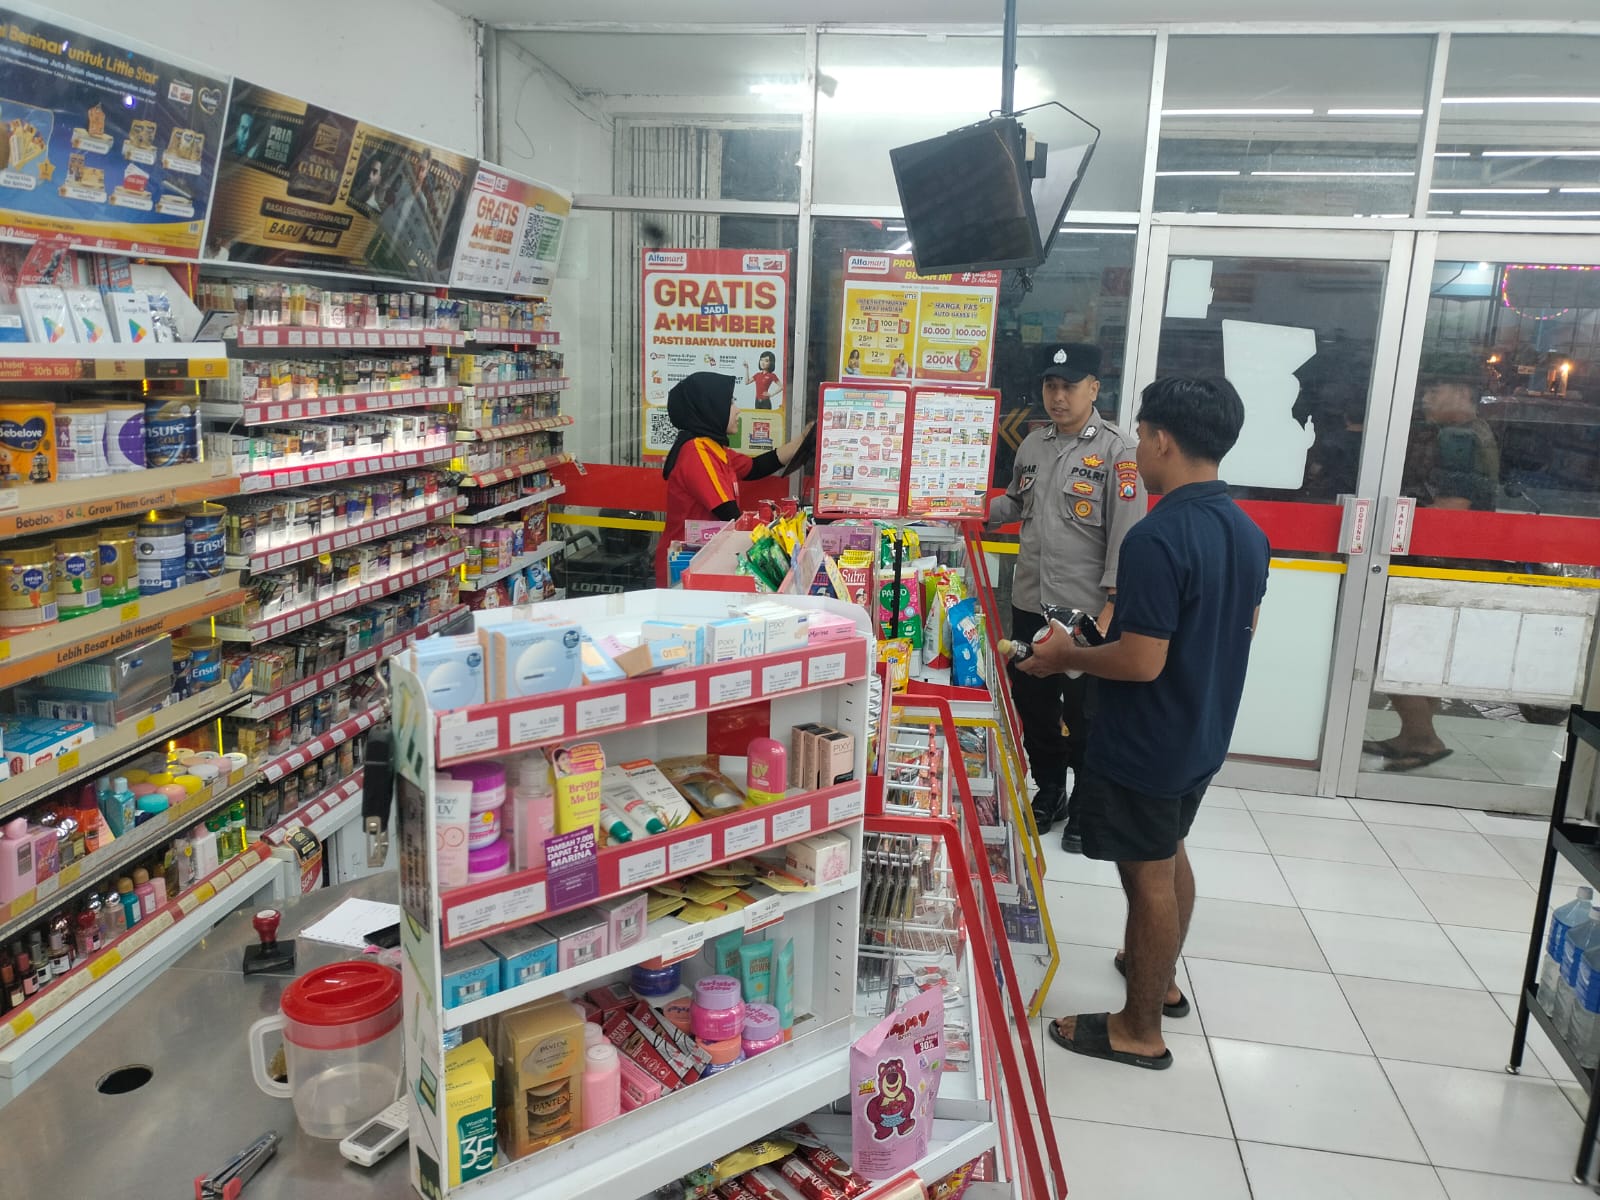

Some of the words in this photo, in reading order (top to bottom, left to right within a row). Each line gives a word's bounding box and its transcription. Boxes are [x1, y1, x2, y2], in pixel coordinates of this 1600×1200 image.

[68, 46, 104, 69] untuk
[106, 57, 135, 78] Little
[135, 66, 159, 85] Star
[268, 125, 292, 142] PRIA
[298, 161, 339, 182] GARAM
[339, 130, 366, 201] KRETEK
[477, 196, 520, 227] GRATIS
[269, 222, 302, 237] BARU
[648, 253, 684, 263] Alfamart
[851, 258, 887, 267] Alfamart
[653, 278, 777, 310] GRATIS
[703, 306, 726, 314] JADI
[934, 302, 960, 311] HARGA
[922, 326, 950, 335] 50.000
[955, 328, 987, 337] 100.000
[653, 335, 684, 345] PASTI
[685, 337, 727, 347] BANYAK
[728, 338, 776, 349] UNTUNG!
[925, 354, 954, 365] 200K
[1071, 467, 1105, 481] POLRI
[15, 514, 56, 530] Bebelac
[65, 507, 74, 520] &
[88, 502, 113, 517] Grow
[115, 498, 139, 511] Them
[140, 494, 166, 506] Great!
[1355, 506, 1365, 541] DORONG
[1396, 506, 1404, 540] TARIK
[571, 582, 624, 593] LONCIN
[57, 648, 82, 664] Lebih
[84, 640, 108, 654] Besar
[110, 630, 133, 646] Lebih
[833, 743, 851, 753] PIXY
[438, 804, 454, 815] UV
[547, 839, 576, 853] TAMBAH
[576, 833, 594, 845] 7.000
[547, 847, 572, 861] DAPAT
[573, 845, 579, 853] 2
[580, 841, 594, 851] PCS
[551, 849, 592, 868] MARINA
[532, 1091, 574, 1113] PANTENE
[460, 1134, 494, 1171] 35
